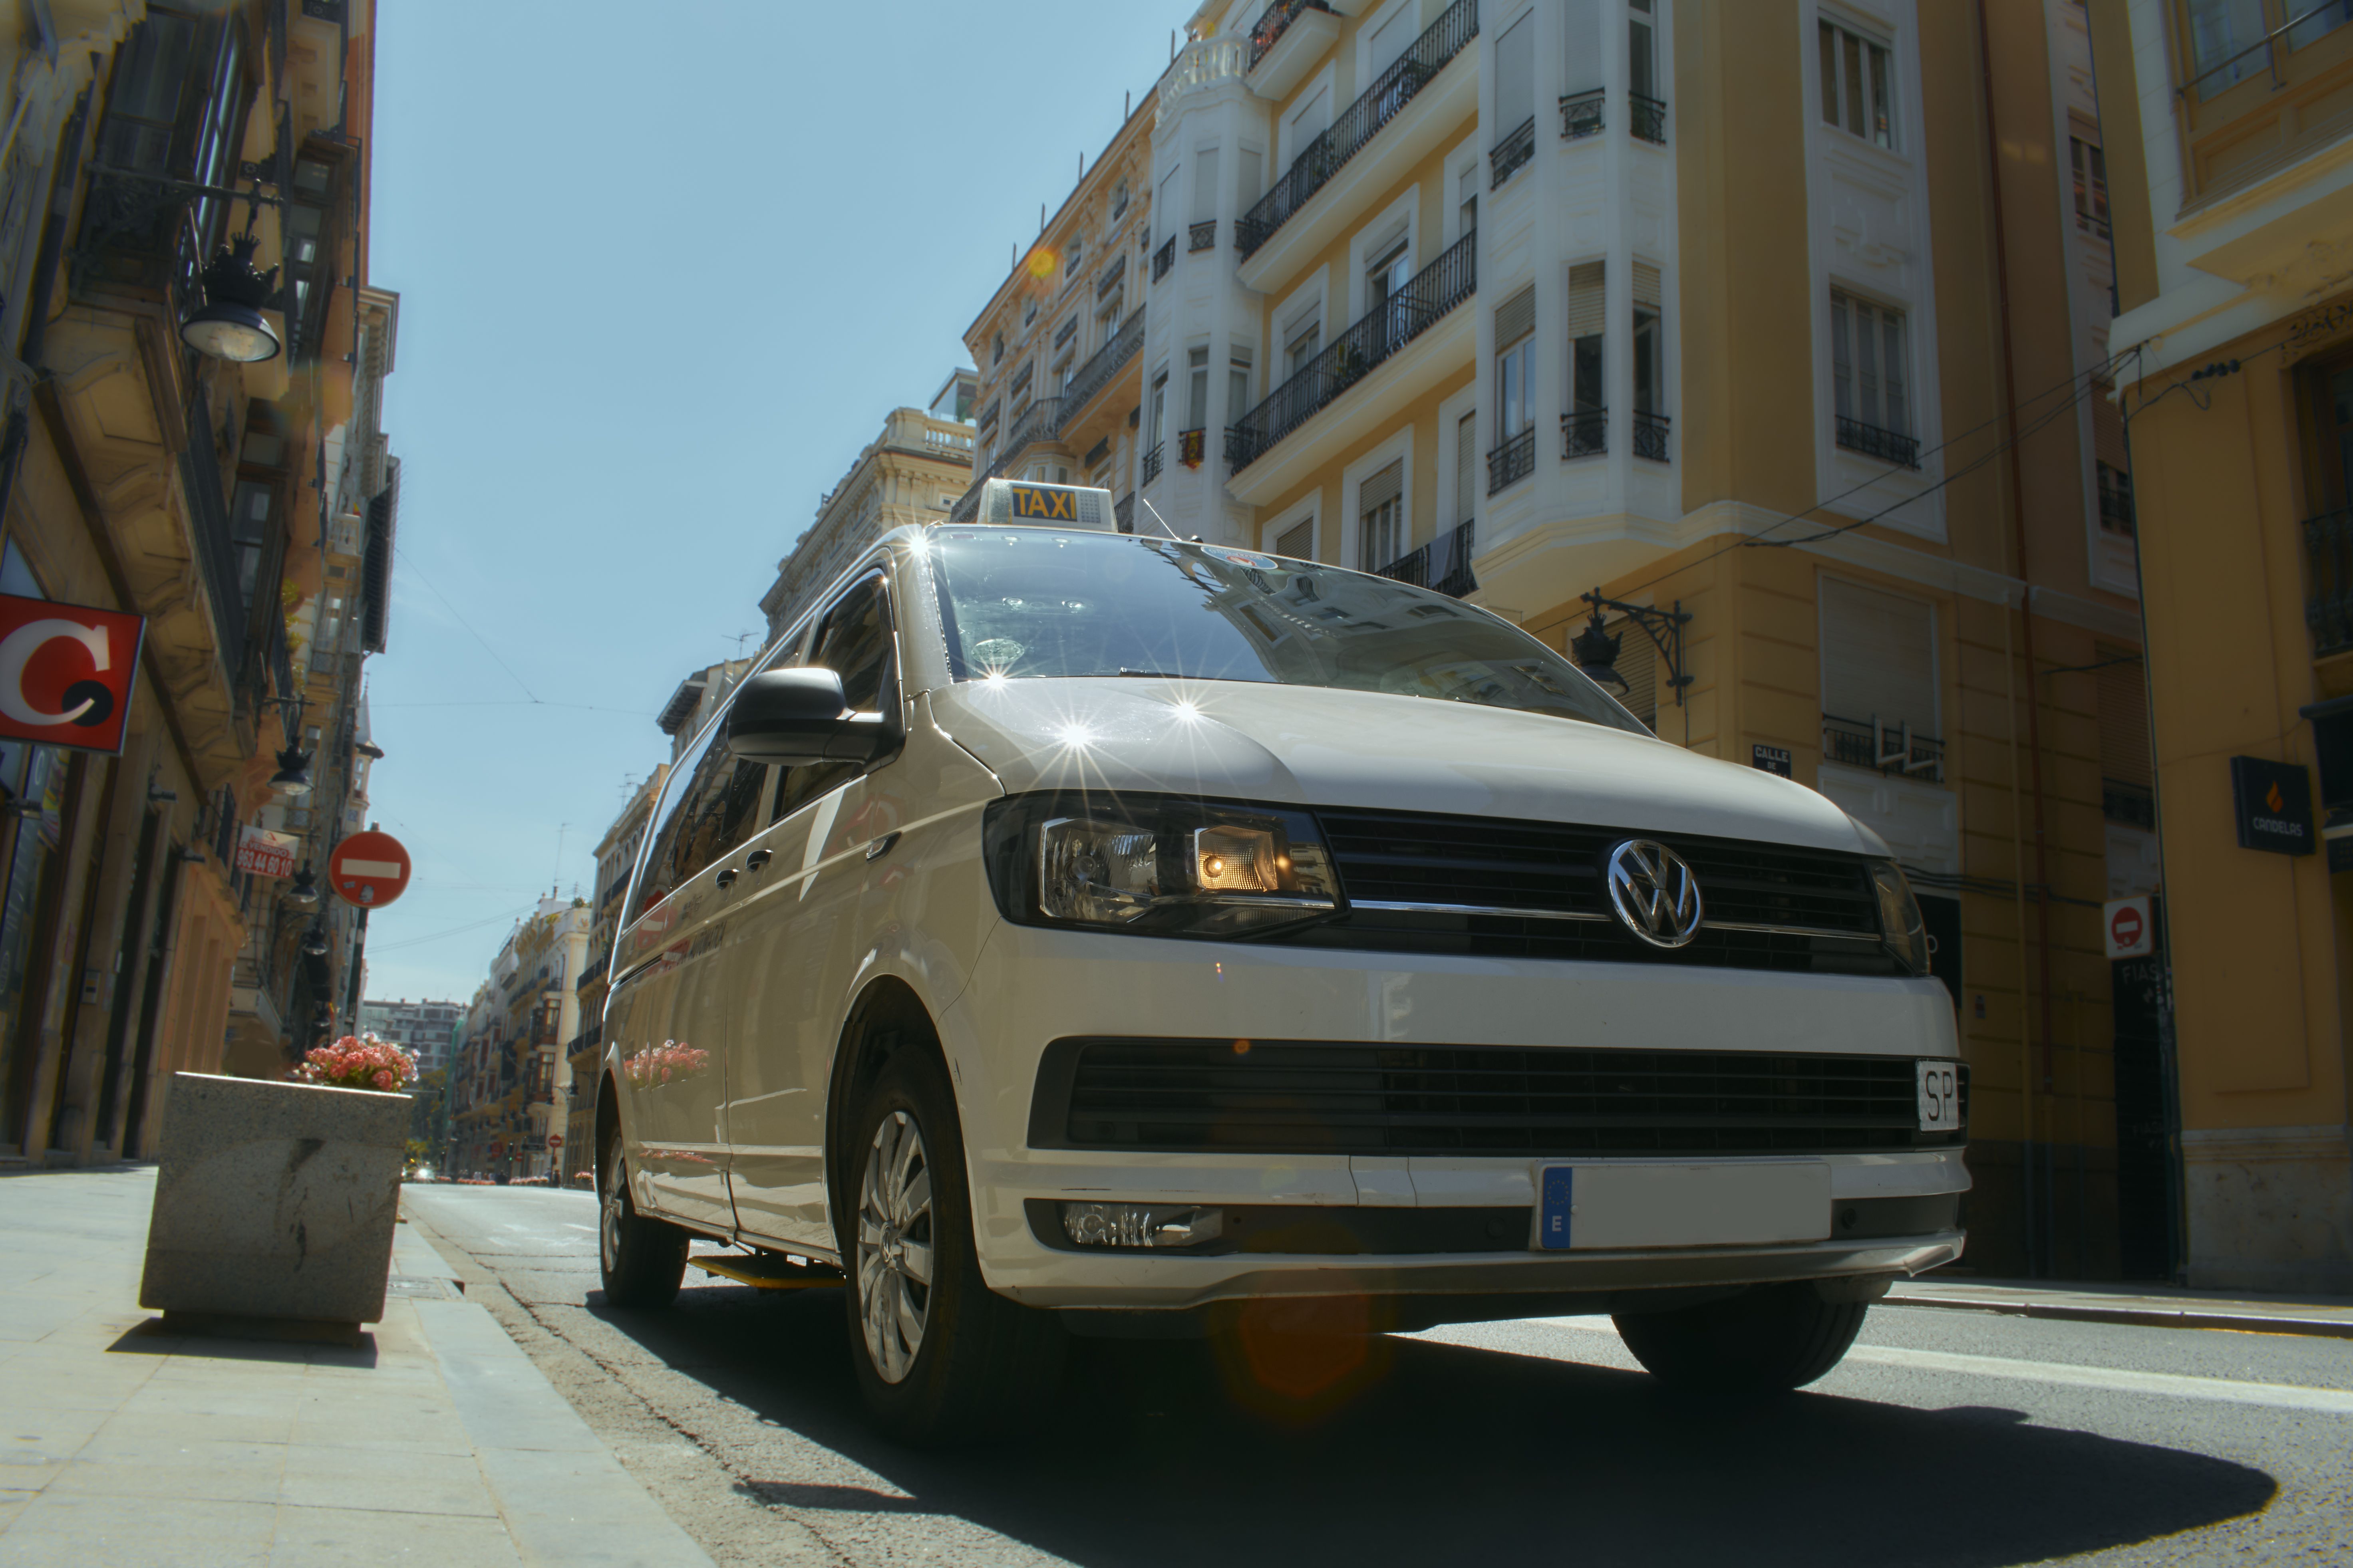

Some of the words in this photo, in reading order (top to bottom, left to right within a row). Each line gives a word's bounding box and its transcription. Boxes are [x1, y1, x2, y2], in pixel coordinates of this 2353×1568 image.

[1013, 488, 1076, 519] TAXI
[1755, 746, 1789, 763] CALLE
[1767, 761, 1777, 770] DE
[2253, 817, 2303, 837] CANDELAS
[249, 842, 288, 857] VENDIDO
[236, 849, 255, 869] 963
[255, 853, 267, 871] 44
[267, 856, 280, 875] 60
[280, 859, 293, 877] 10
[1926, 1071, 1952, 1121] SP
[1552, 1215, 1562, 1232] E
